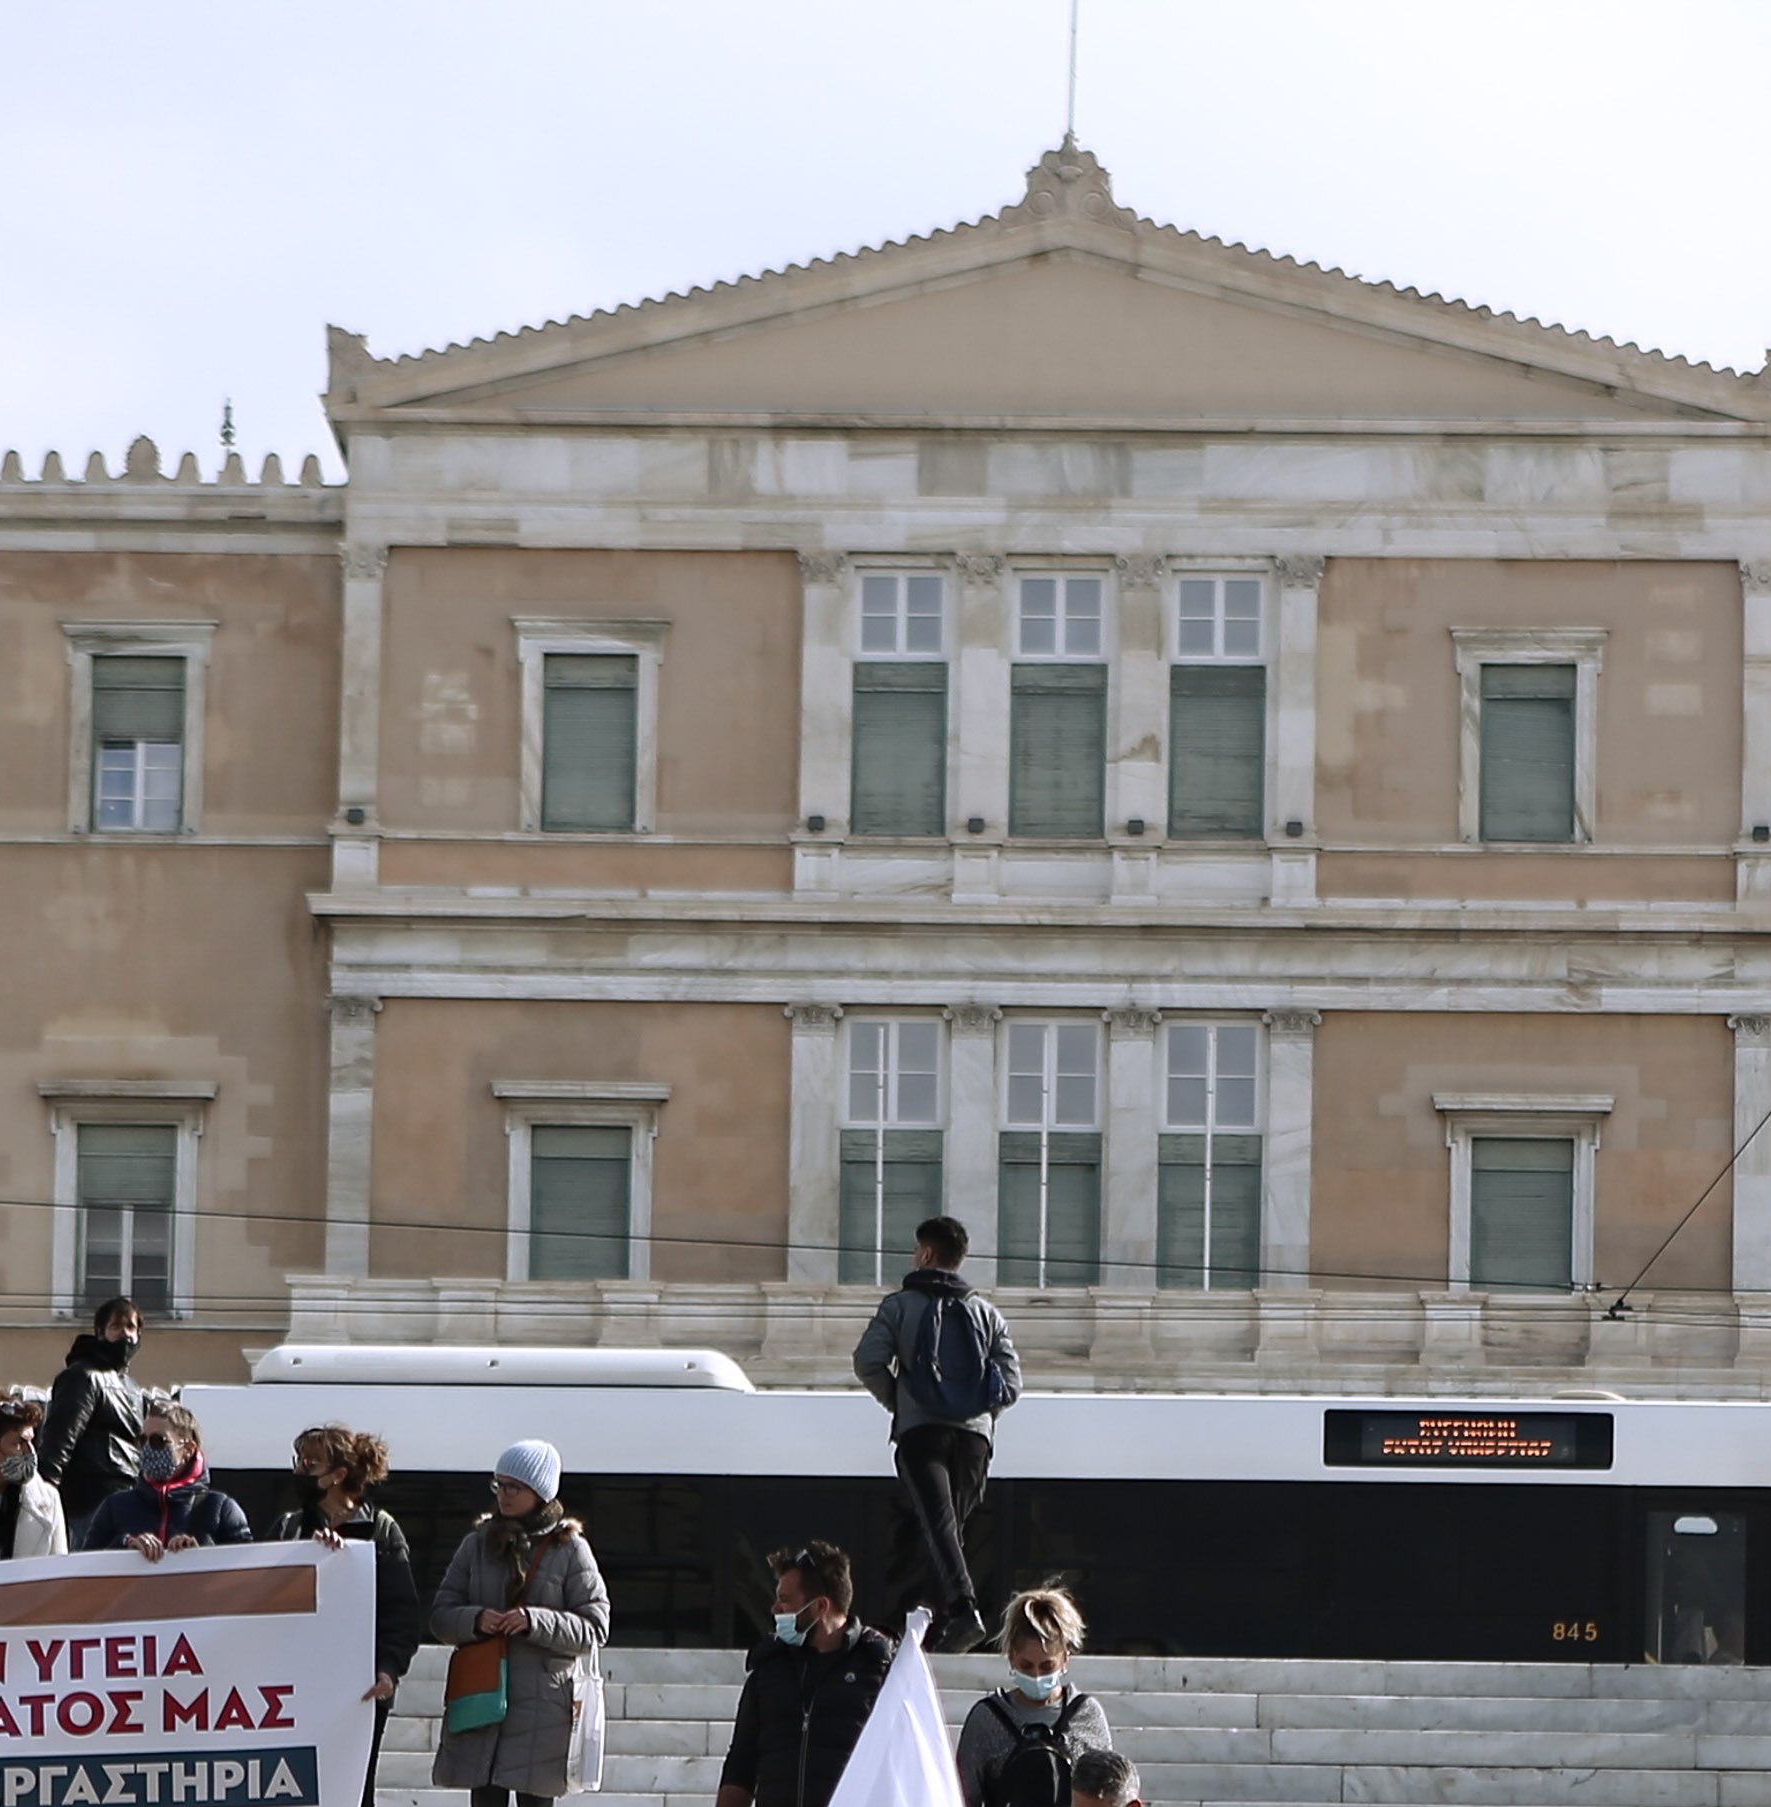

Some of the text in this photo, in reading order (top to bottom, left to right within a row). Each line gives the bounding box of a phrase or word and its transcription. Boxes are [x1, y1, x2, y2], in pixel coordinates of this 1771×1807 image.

[1552, 1622, 1598, 1642] 845
[26, 1632, 204, 1682] ΥΓΕΙΑ
[162, 1684, 296, 1733] ΜΑΣ
